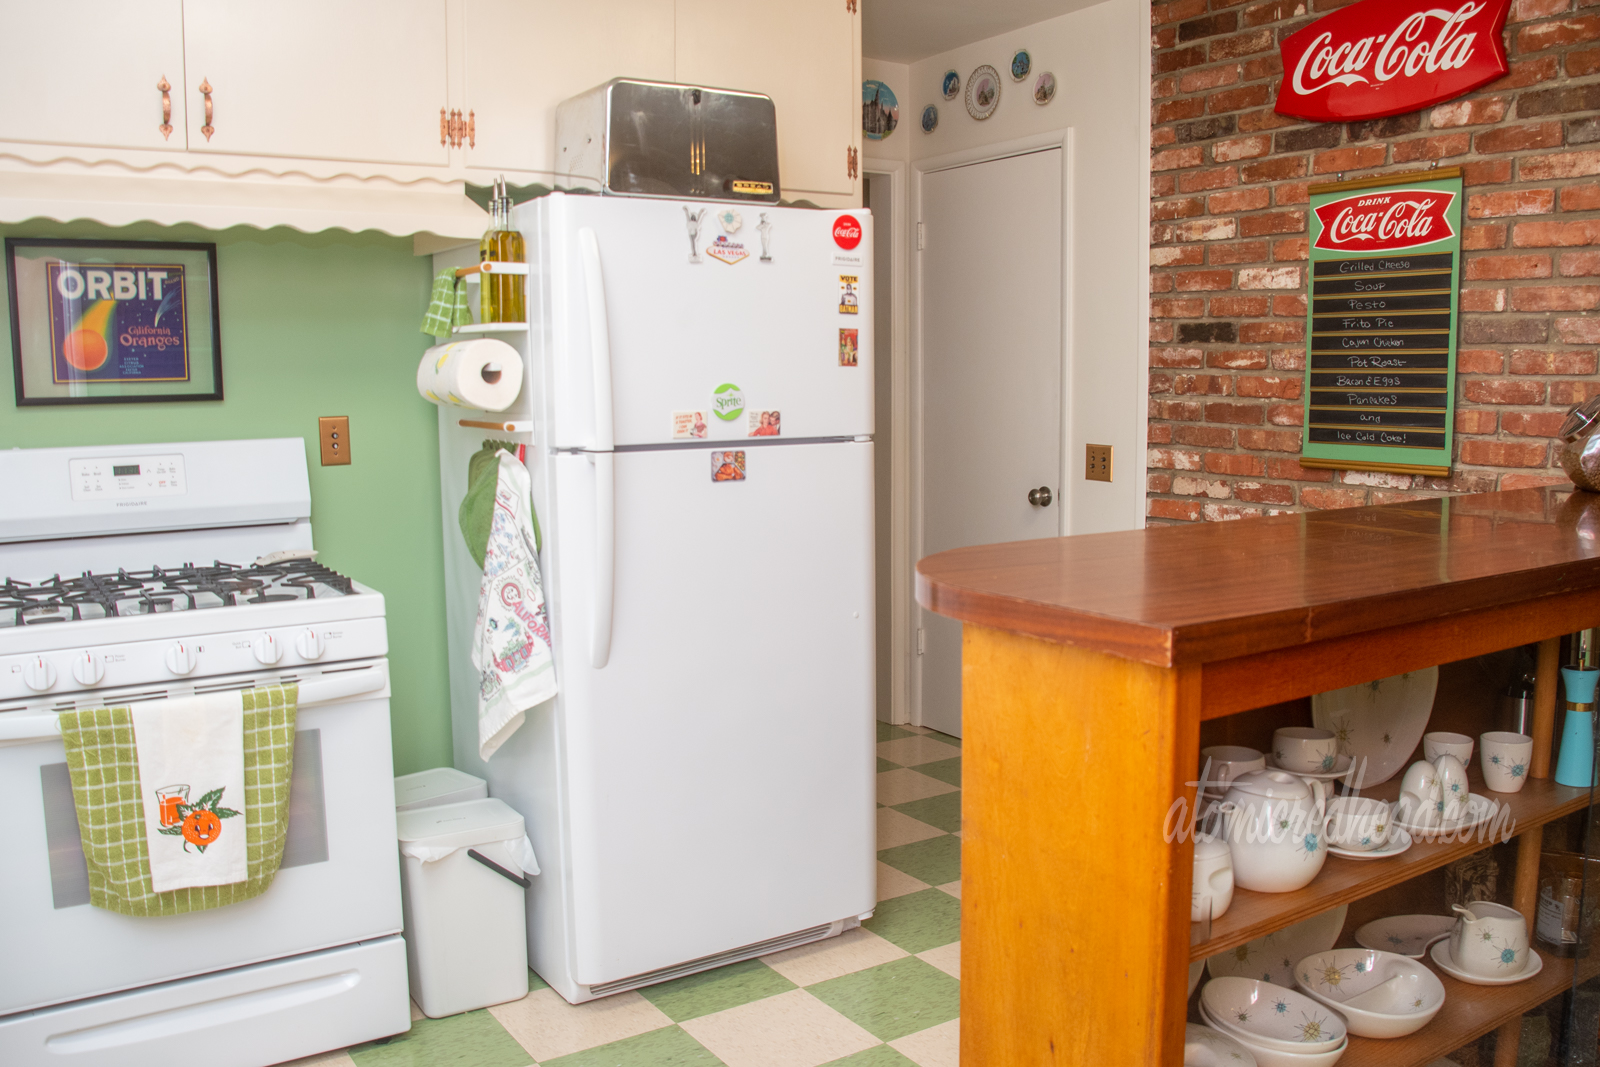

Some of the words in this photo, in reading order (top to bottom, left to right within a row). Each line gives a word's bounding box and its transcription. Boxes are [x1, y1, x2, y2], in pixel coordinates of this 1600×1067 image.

[1292, 1, 1487, 95] Coca-Cola
[1357, 196, 1392, 207] DRINK
[1330, 198, 1437, 244] Coca-Cola
[727, 249, 747, 257] VEGAS
[1339, 260, 1375, 273] Grilled
[1378, 259, 1411, 270] Cheese
[57, 269, 168, 300] ORBIT
[1347, 299, 1386, 310] Pesto
[1342, 318, 1371, 329] Frito
[1375, 317, 1394, 328] Pie
[128, 325, 171, 335] California
[120, 334, 180, 351] Oranges
[1342, 337, 1369, 348] Cajun
[1373, 337, 1404, 347] Chicken
[1347, 356, 1368, 368] Pot
[1369, 356, 1407, 368] Roast
[716, 396, 742, 410] Sprite
[1347, 394, 1398, 405] Pancakes
[1360, 414, 1381, 423] and
[1337, 431, 1351, 440] Ice
[1356, 432, 1375, 441] Cold
[1380, 432, 1407, 443] Coke!
